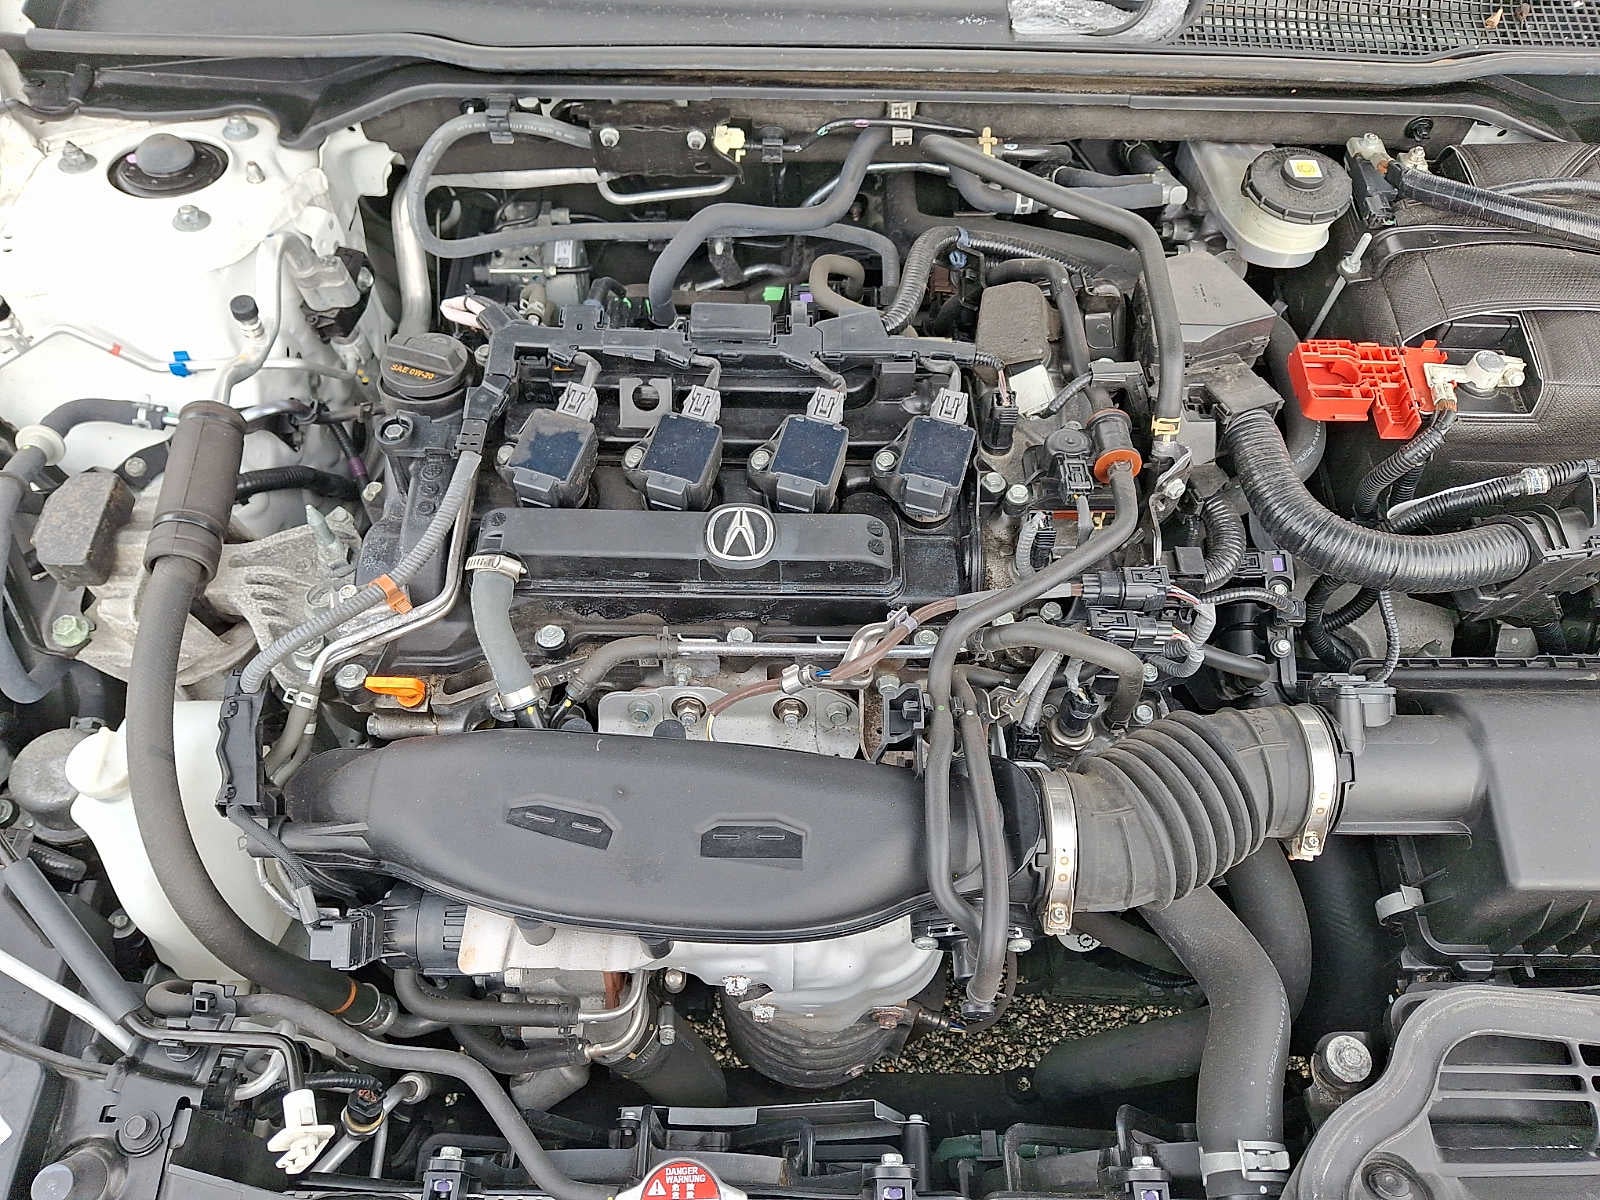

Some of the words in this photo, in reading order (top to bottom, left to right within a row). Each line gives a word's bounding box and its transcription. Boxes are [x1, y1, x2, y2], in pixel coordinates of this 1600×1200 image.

[390, 363, 410, 374] SAE
[665, 1166, 699, 1176] DANGER
[665, 1174, 706, 1184] WARNUNG
